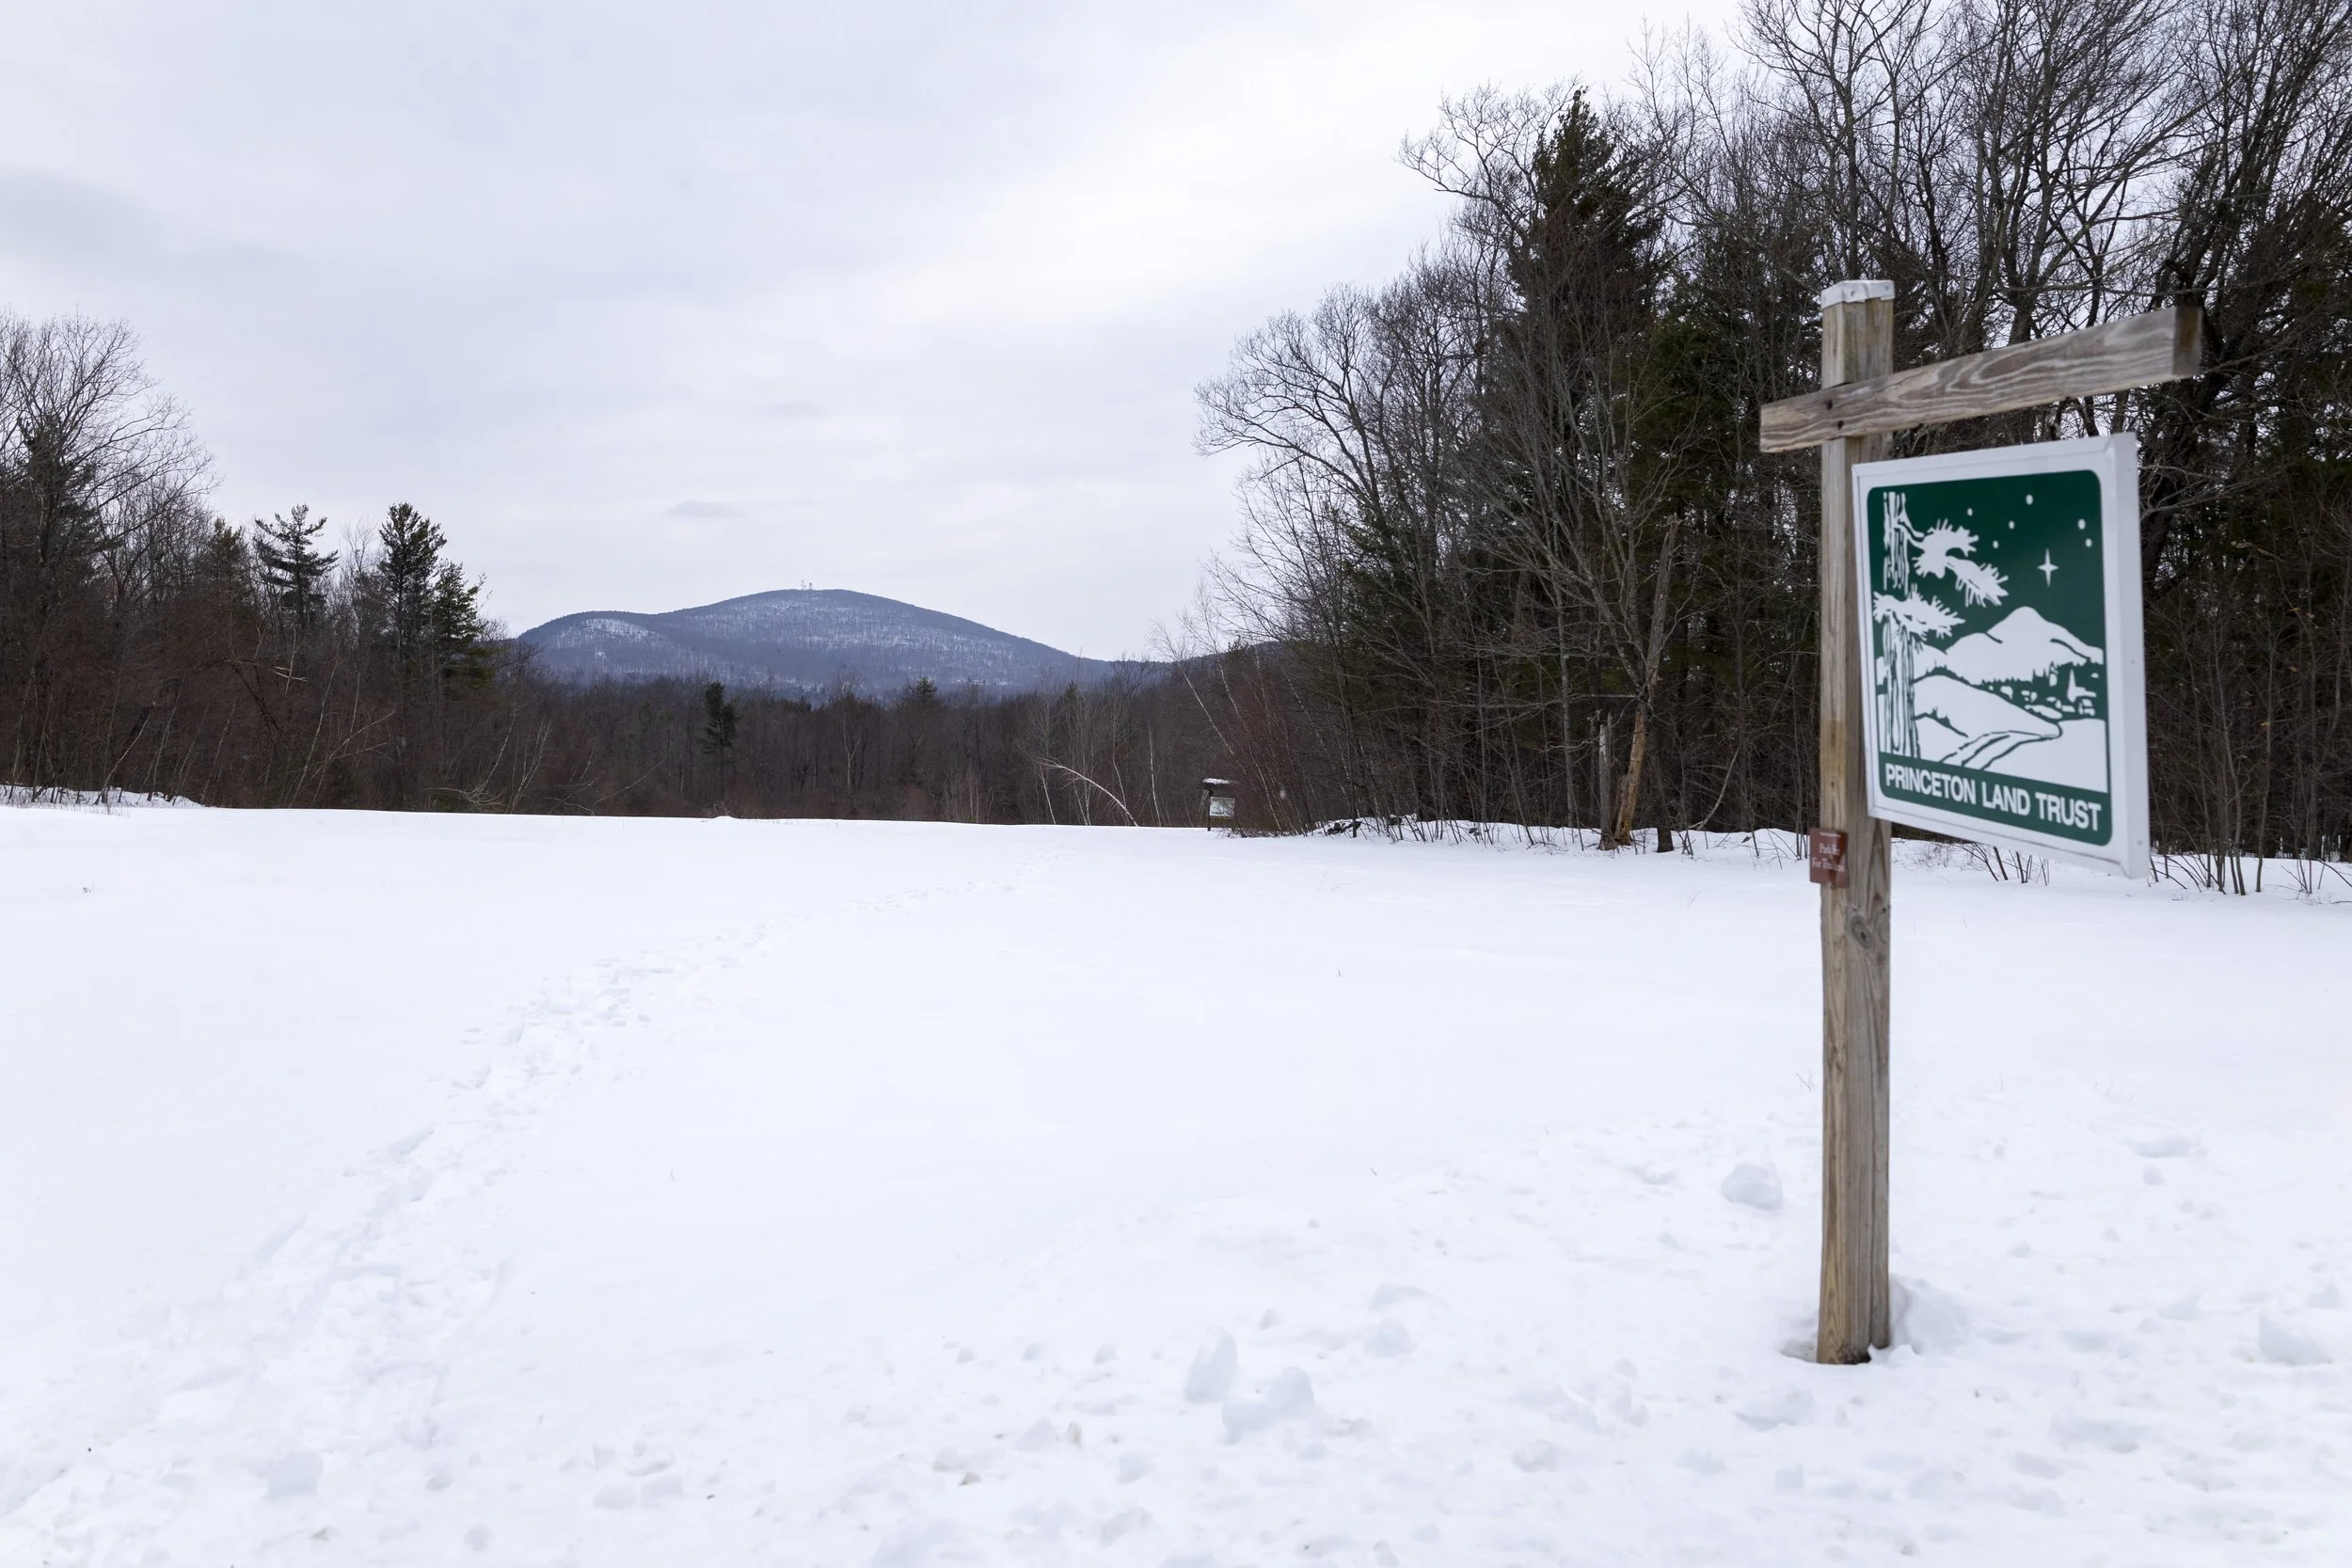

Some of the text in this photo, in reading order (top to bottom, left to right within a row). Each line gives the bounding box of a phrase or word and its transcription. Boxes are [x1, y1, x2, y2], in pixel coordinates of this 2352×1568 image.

[1884, 762, 2102, 832] PRINCETON LAND TRUST
